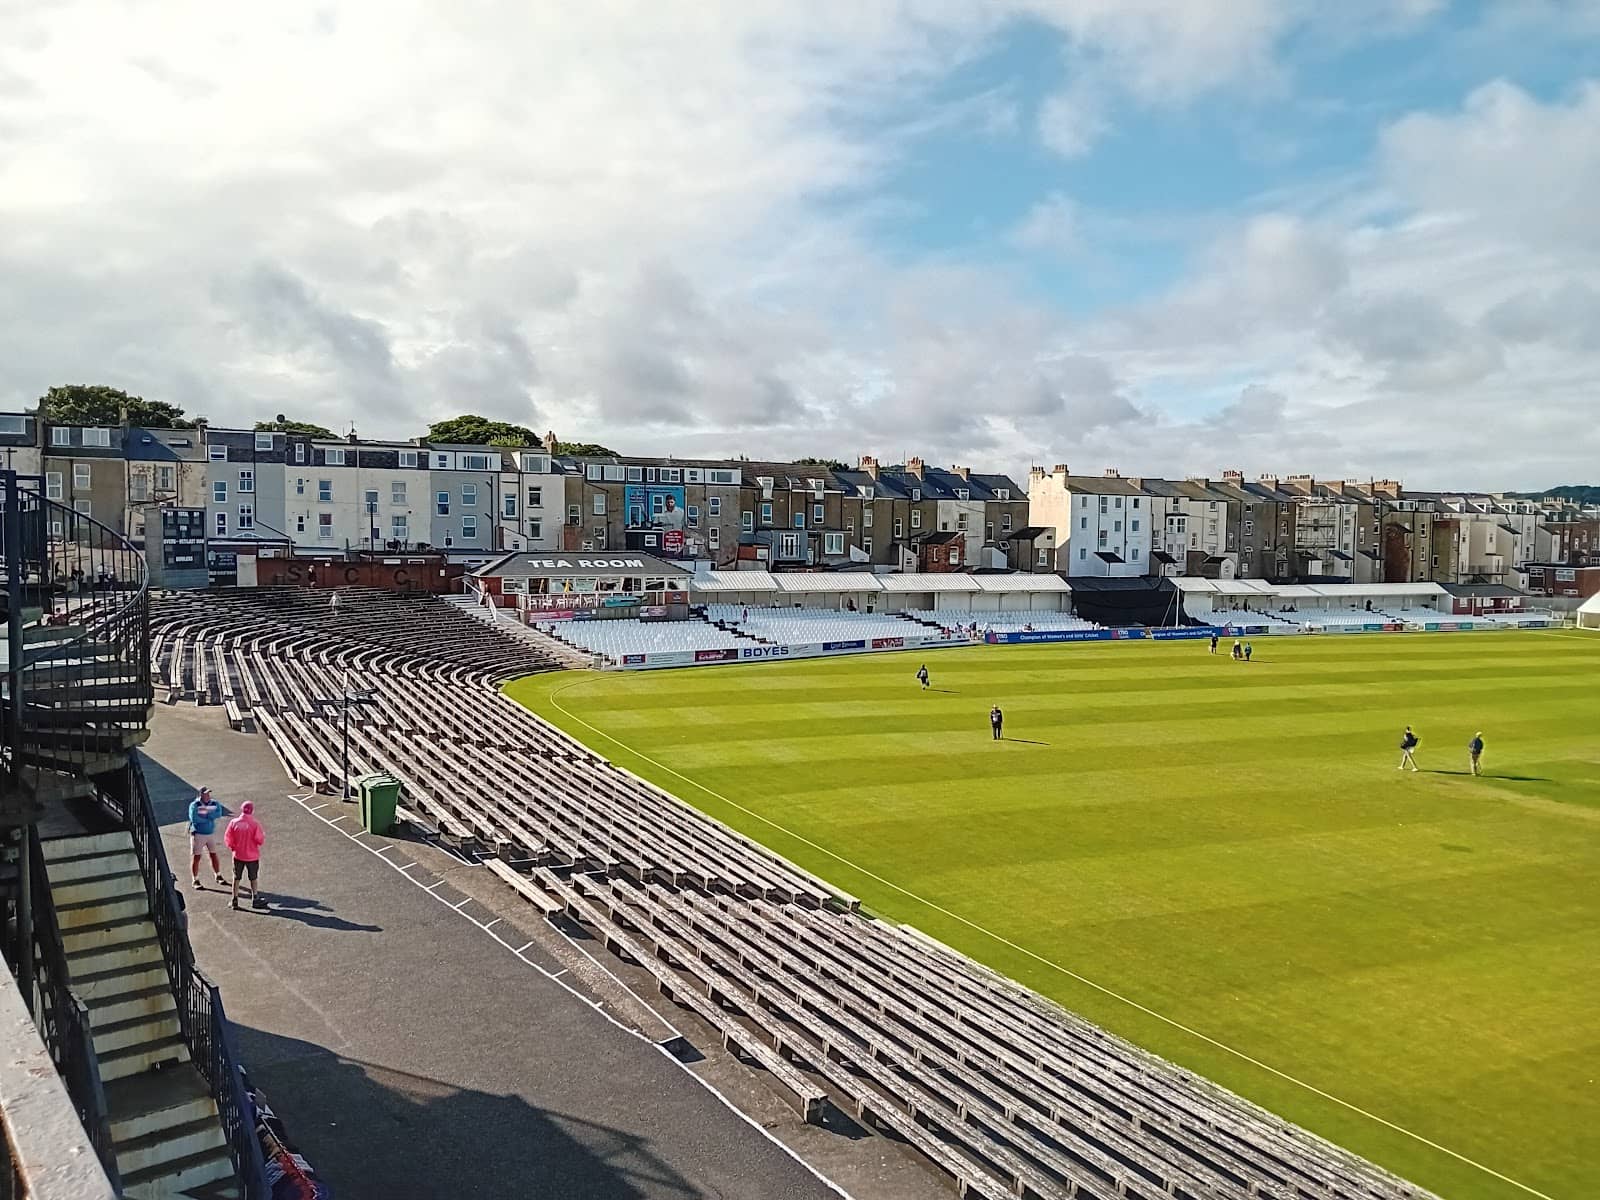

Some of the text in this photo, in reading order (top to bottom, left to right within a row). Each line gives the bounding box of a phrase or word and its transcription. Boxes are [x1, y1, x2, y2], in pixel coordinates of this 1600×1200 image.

[528, 559, 644, 568] TEA ROOM
[287, 566, 408, 585] S C C
[743, 646, 789, 658] BOYES
